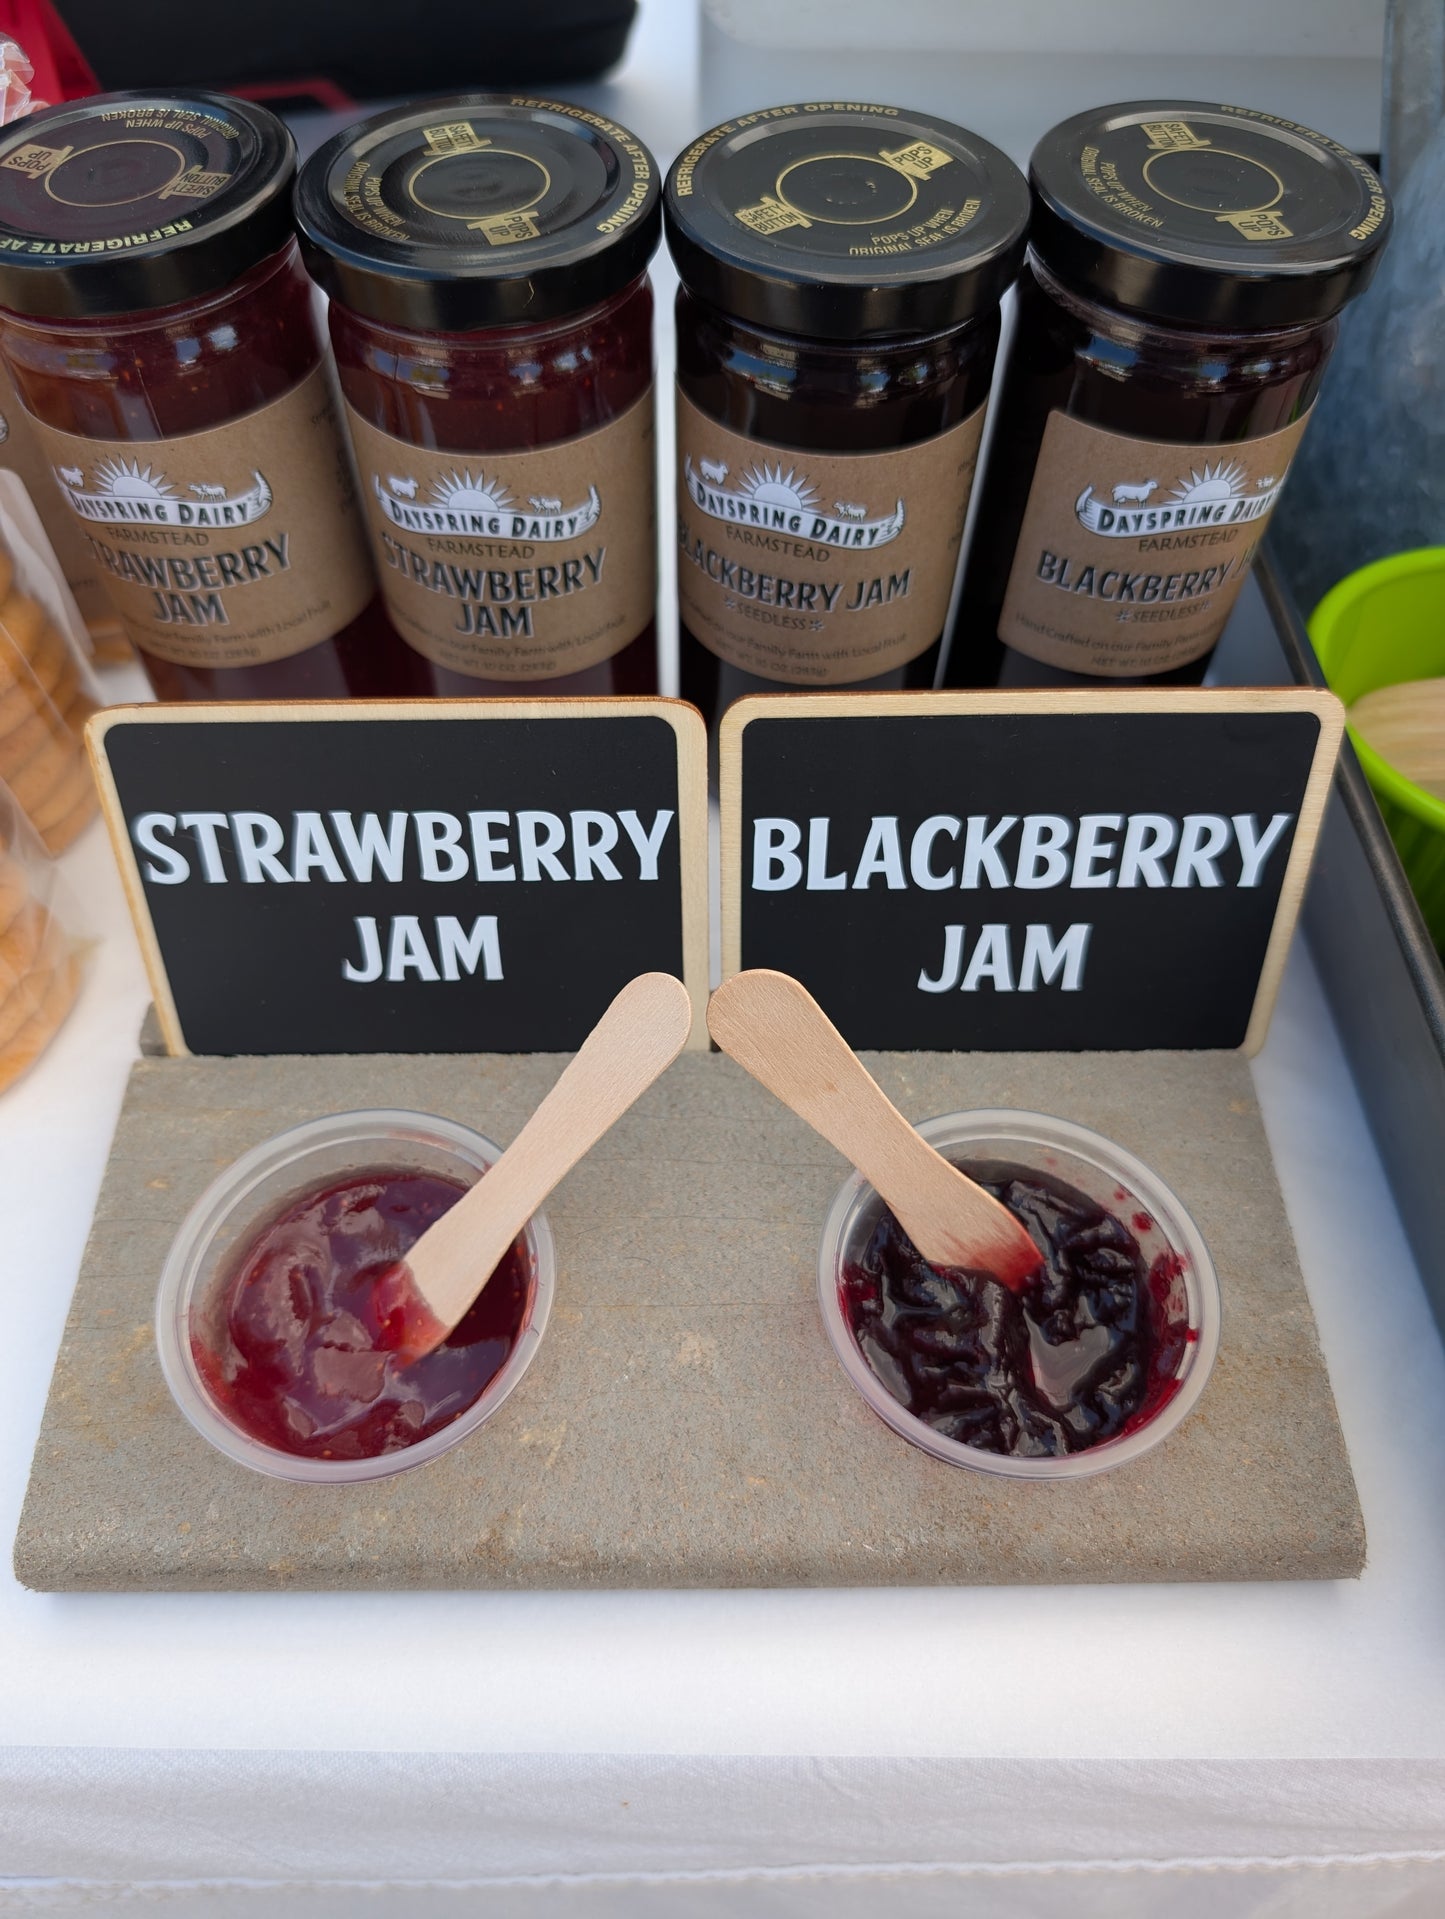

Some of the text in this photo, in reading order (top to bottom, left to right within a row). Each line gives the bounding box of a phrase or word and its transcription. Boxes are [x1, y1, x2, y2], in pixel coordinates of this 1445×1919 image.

[102, 108, 155, 122] BROKEN
[126, 119, 212, 139] POPS UP WHEN
[1165, 122, 1197, 147] SAFETY
[8, 157, 51, 171] POPS
[28, 150, 52, 161] UP
[676, 104, 899, 197] REFRIGERATE AFTER OPENING
[893, 145, 932, 166] POPS
[913, 156, 936, 170] UP
[181, 172, 228, 184] BUTTON
[511, 98, 651, 233] REFRIGERATE AFTER OPENING
[1221, 105, 1386, 241] REFRIGERATE AFTER OPENING
[171, 184, 216, 196] SAFETY
[504, 216, 533, 239] POPS
[746, 203, 785, 224] SAFETY
[754, 211, 800, 232] BUTTON
[871, 208, 956, 245] POPS UP WHEN
[941, 223, 959, 235] IS
[954, 199, 981, 229] BROKEN
[1238, 221, 1263, 233] UP
[1251, 213, 1286, 237] POPS
[28, 219, 193, 254] REFRIGERATE
[489, 225, 511, 237] UP
[69, 489, 249, 526] DAYSPRING DAIRY
[389, 499, 579, 539] DAYSPRING DAIRY
[696, 482, 880, 547] DAYSPRING DAIRY
[1098, 504, 1225, 532] DAYSPRING
[106, 526, 209, 546] FARMSTEAD
[427, 537, 536, 560] FARMSTEAD
[725, 525, 830, 562] FARMSTEAD
[1138, 528, 1240, 552] FARMSTEAD
[382, 532, 608, 604] STRAWBERRY
[1035, 549, 1237, 605] BLACKBERRY
[846, 567, 913, 612] JAM
[154, 591, 230, 627] JAM
[455, 602, 535, 639] JAM
[737, 602, 807, 630] SEEDLESS
[1132, 603, 1201, 623] SEEDLESS
[131, 809, 675, 885] STRAWBERRY
[751, 812, 1294, 892] BLACKBERRY
[341, 914, 504, 983] JAM
[917, 922, 1093, 993] JAM
